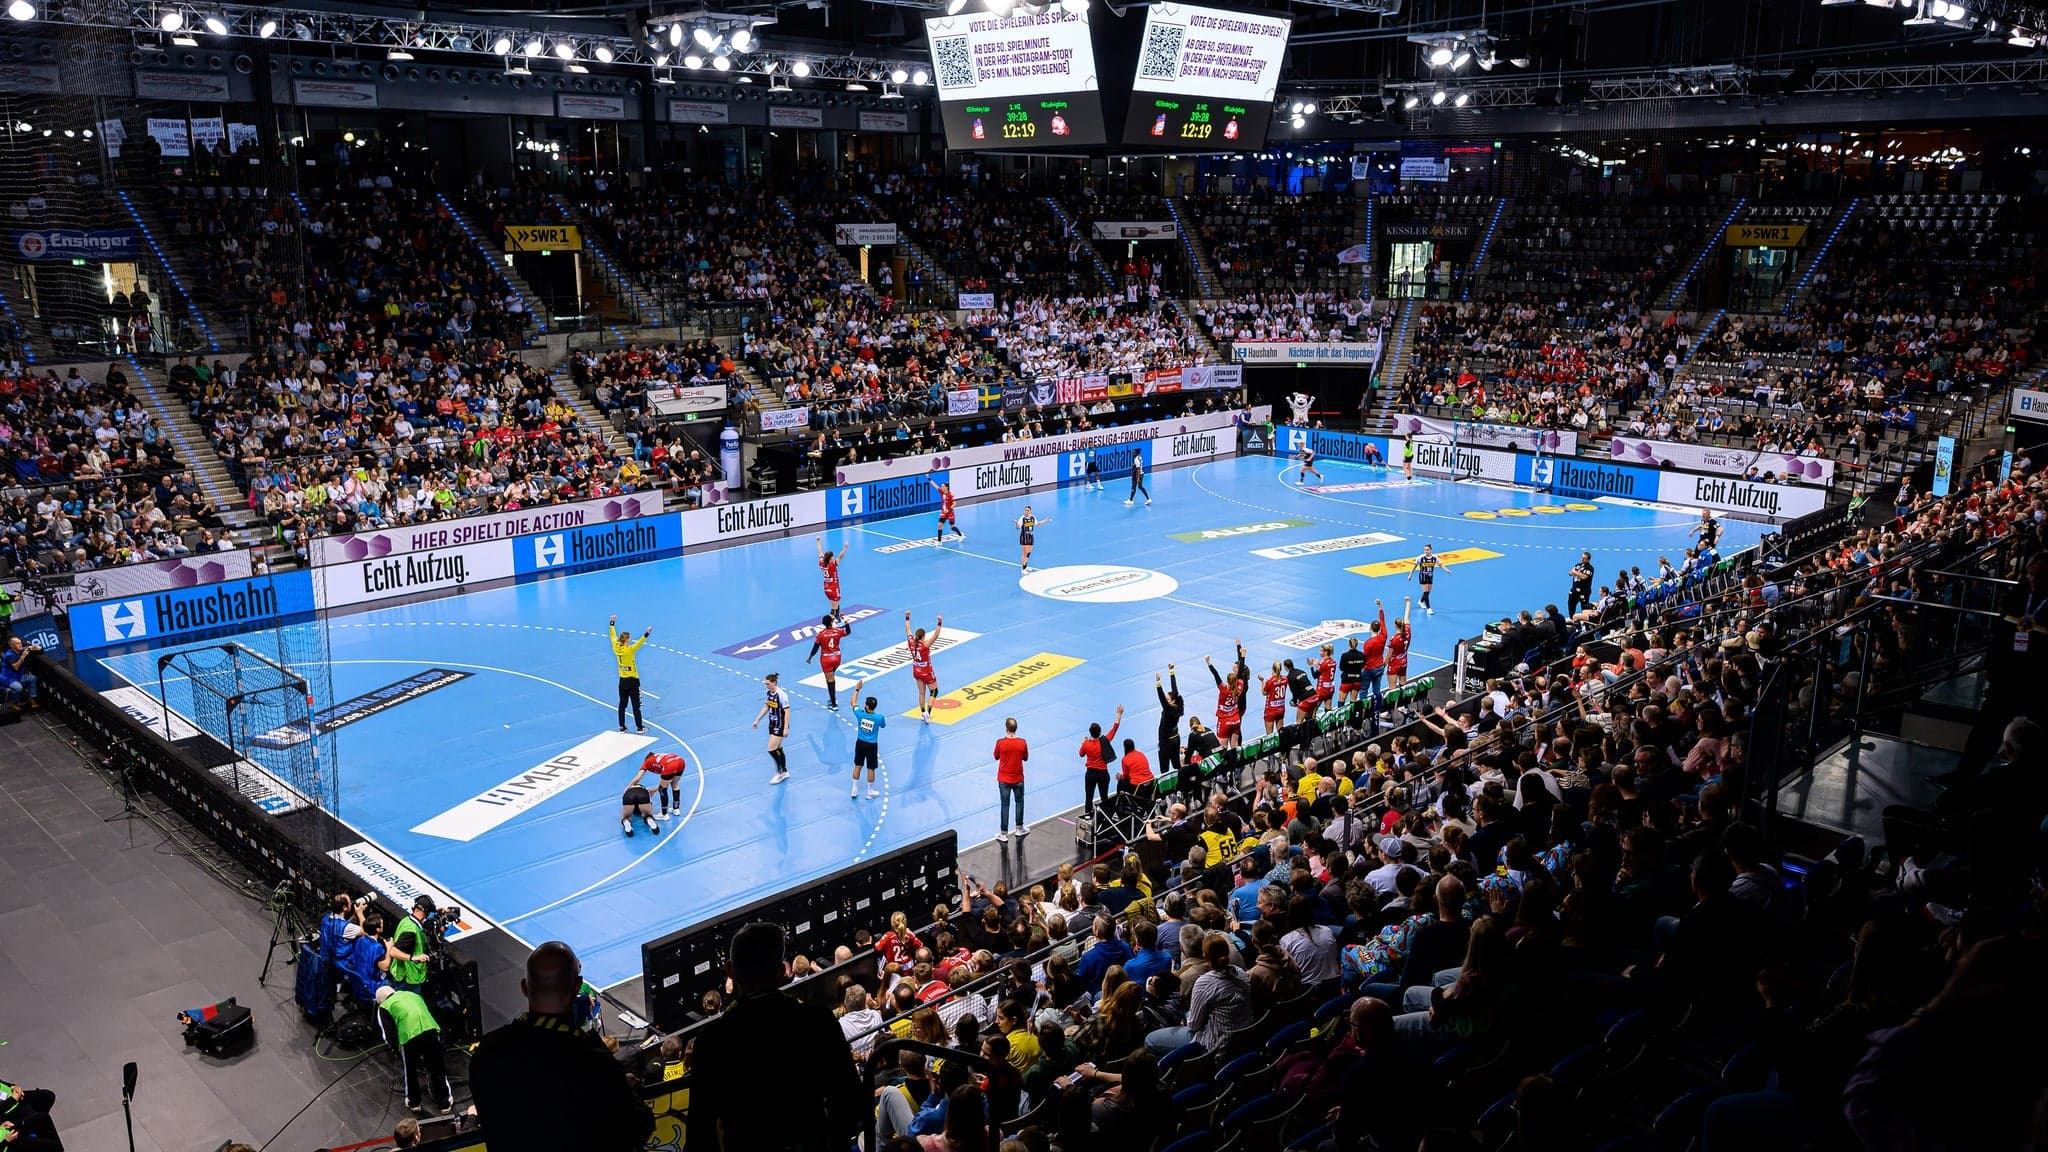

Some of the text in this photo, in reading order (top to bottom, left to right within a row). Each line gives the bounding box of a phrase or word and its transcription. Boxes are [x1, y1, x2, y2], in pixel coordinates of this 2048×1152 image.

[969, 21, 986, 32] VOTE
[988, 19, 998, 30] DIE
[1000, 14, 1034, 29] SPIELERIN
[1036, 12, 1050, 25] DES
[1190, 15, 1282, 37] VOTE DIE SPIELERIN DES SPIELS!
[974, 38, 1050, 54] AB DER 50. SPIELMINUTE
[1185, 39, 1254, 56] AB DER 50. SPIELMINUTE
[976, 48, 1073, 67] IN DER HBF-INSTAGRAM-STORY
[1183, 52, 1268, 70] IN DER HBF-INSTAGRAM-STORY
[992, 68, 996, 78] 5
[996, 66, 1011, 78] MIN.
[1012, 65, 1030, 77] NACH
[1192, 65, 1197, 75] 5
[1197, 66, 1211, 78] MIN.
[1211, 68, 1228, 79] NACH
[1007, 112, 1027, 122] 39:28
[1190, 112, 1209, 122] 39:28
[1003, 123, 1035, 138] 12:19
[1181, 123, 1212, 138] 12:19
[1386, 227, 1469, 235] KESSLER SEKT
[50, 234, 130, 249] Ensinger
[1248, 348, 1277, 358] Haushahn
[1289, 347, 1314, 358] Nächster
[1331, 348, 1341, 358] das
[1343, 348, 1374, 360] Treppchen
[1173, 433, 1217, 456] Echt Aufzug.
[1417, 444, 1440, 466] Echt
[976, 462, 1033, 489] Echt Aufzug.
[1560, 462, 1634, 495] Haushahn
[868, 478, 930, 512] Haushahn
[1696, 477, 1781, 514] Echt Aufzug.
[718, 501, 794, 534] Echt Aufzug.
[412, 510, 584, 550] HIER SPIELT DIE ACTION
[571, 523, 656, 562] Haushahn
[363, 554, 470, 593] Echt Aufzug.
[67, 593, 73, 602] 4
[155, 582, 278, 633] Haushahn
[31, 632, 59, 648] ella
[828, 638, 834, 649] 4
[962, 660, 1051, 700] Lippische
[1330, 669, 1334, 679] 5
[1275, 685, 1286, 698] 30
[511, 755, 580, 789] MHP
